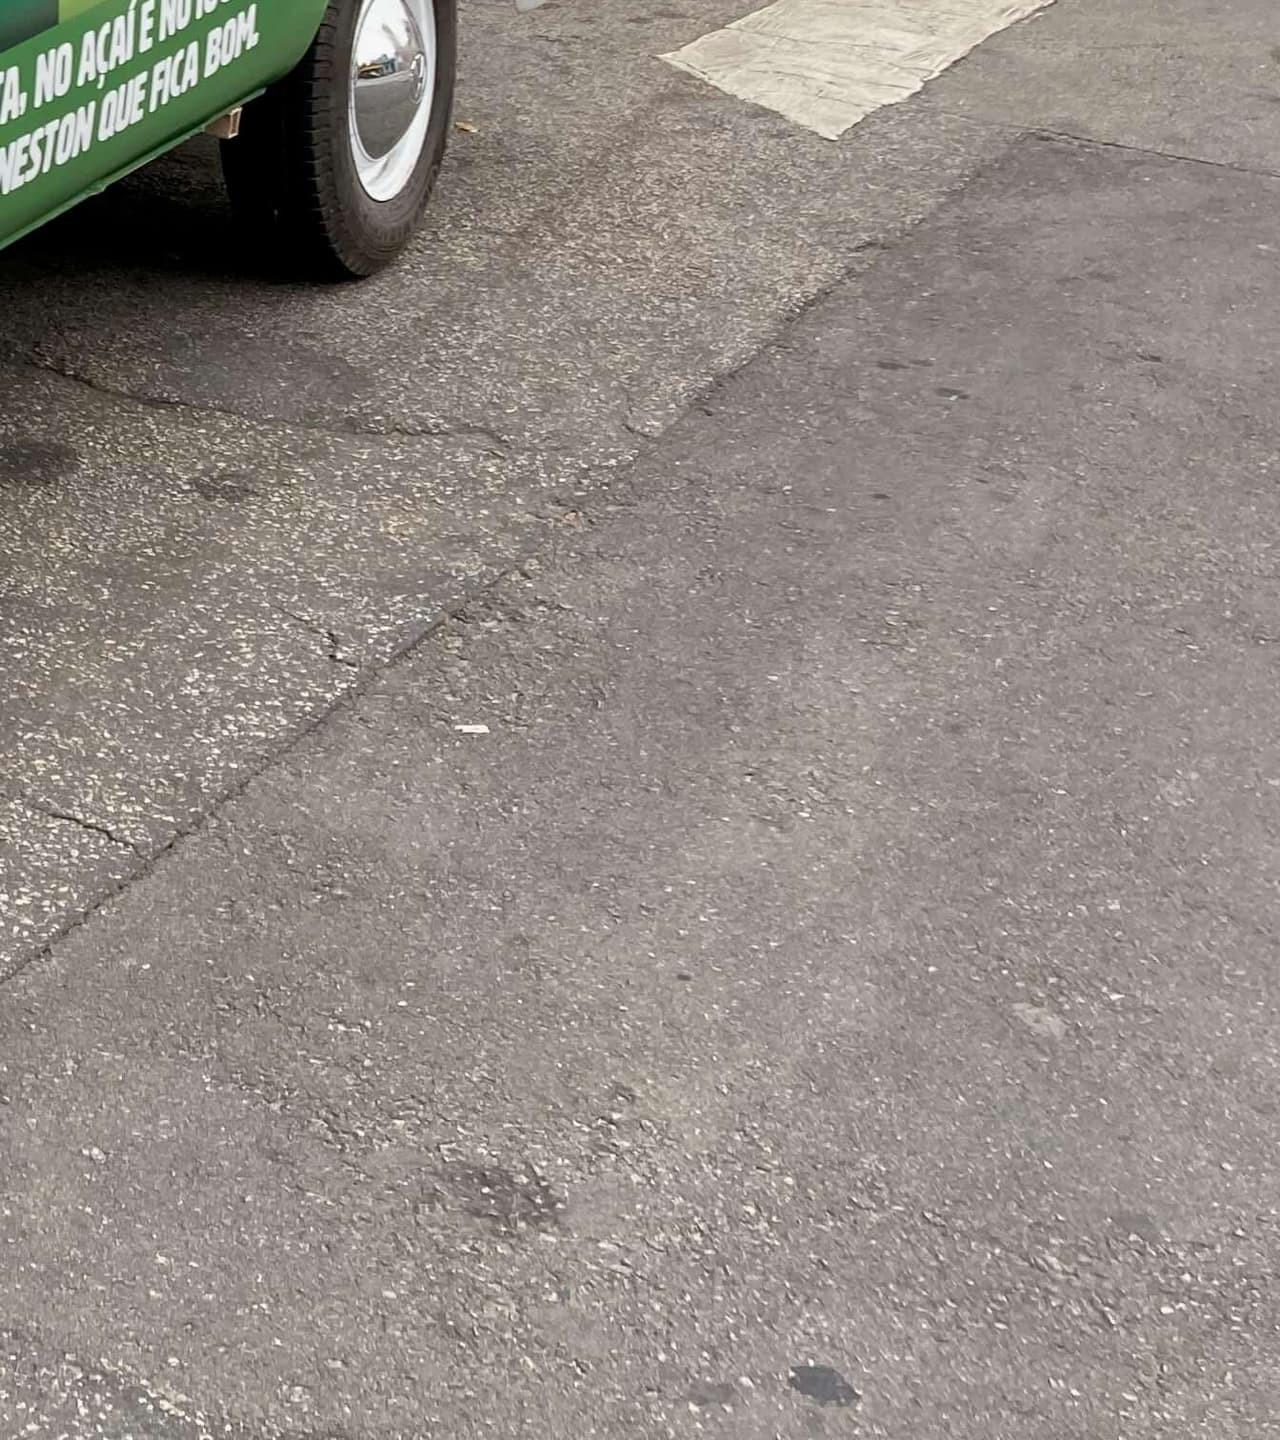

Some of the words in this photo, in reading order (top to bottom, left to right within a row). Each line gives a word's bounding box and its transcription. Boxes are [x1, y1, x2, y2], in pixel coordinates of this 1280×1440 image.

[34, 42, 72, 108] NO
[98, 71, 144, 142] QUE
[148, 41, 198, 113] FICA
[203, 3, 259, 79] BOM.
